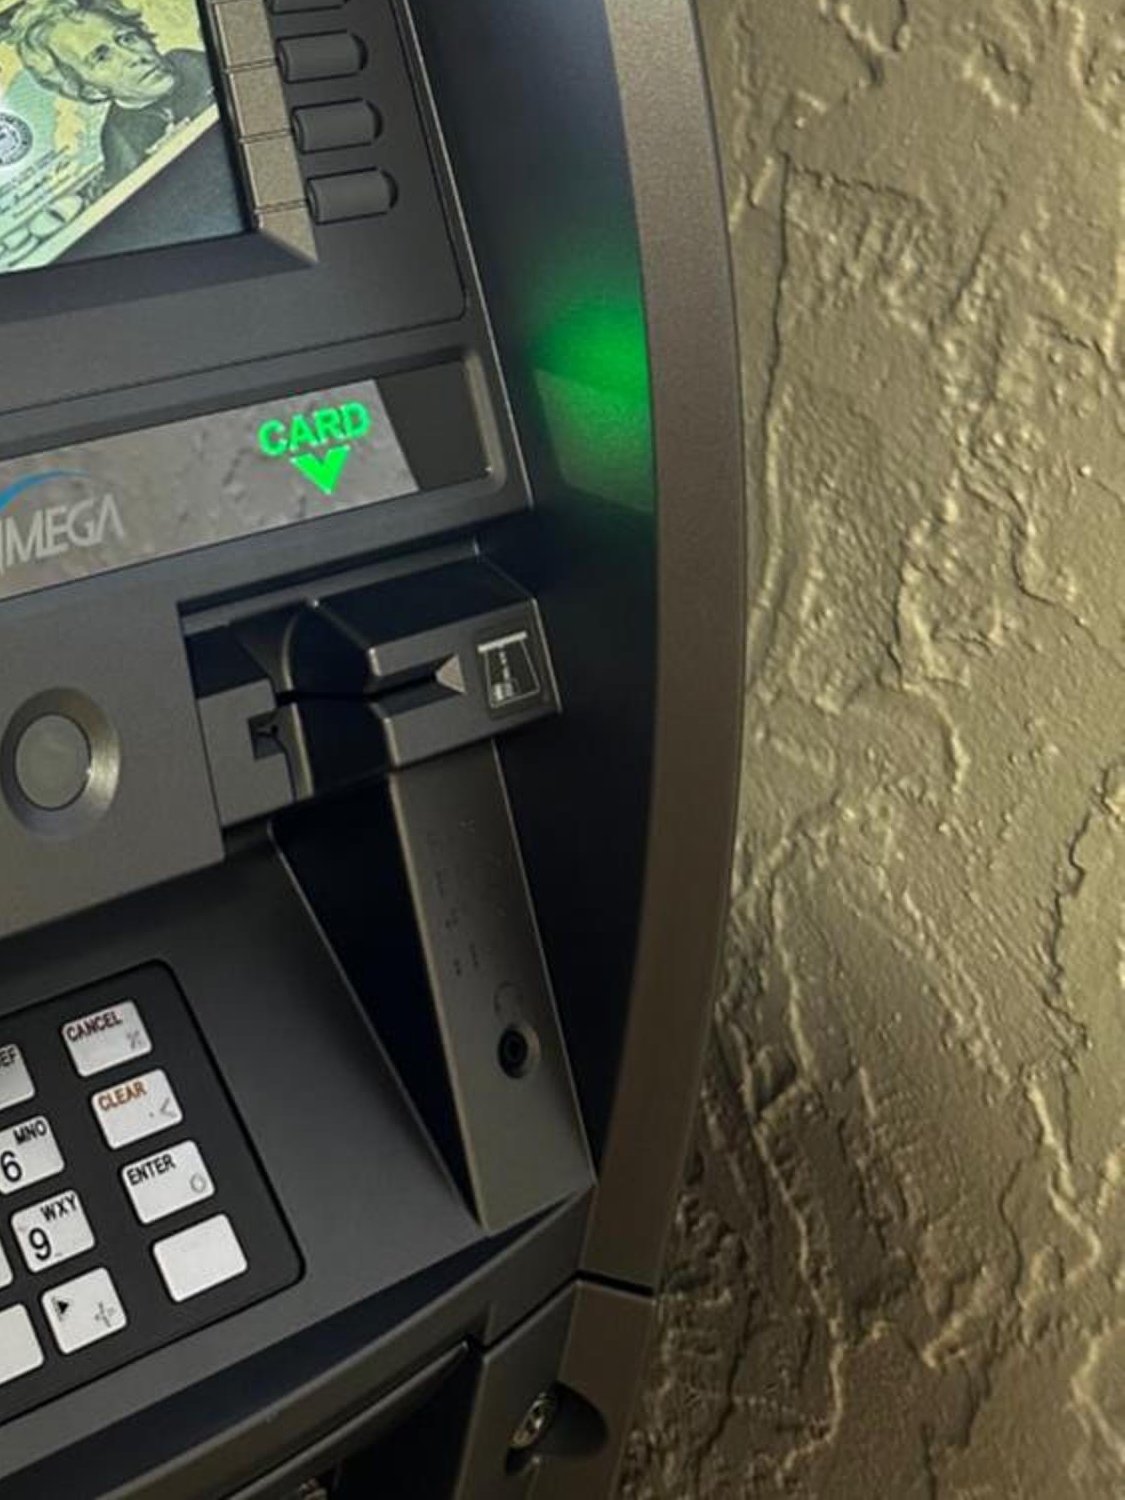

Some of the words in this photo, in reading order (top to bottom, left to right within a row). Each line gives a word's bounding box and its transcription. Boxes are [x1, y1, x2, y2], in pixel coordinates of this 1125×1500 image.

[258, 402, 371, 456] CARD
[65, 1009, 124, 1042] CANCEL
[96, 1080, 147, 1112] CLEAR
[12, 1119, 48, 1145] MNO
[0, 1150, 23, 1183] 6
[125, 1153, 176, 1186] ENTER
[40, 1194, 77, 1221] WXY
[27, 1227, 53, 1261] 9
